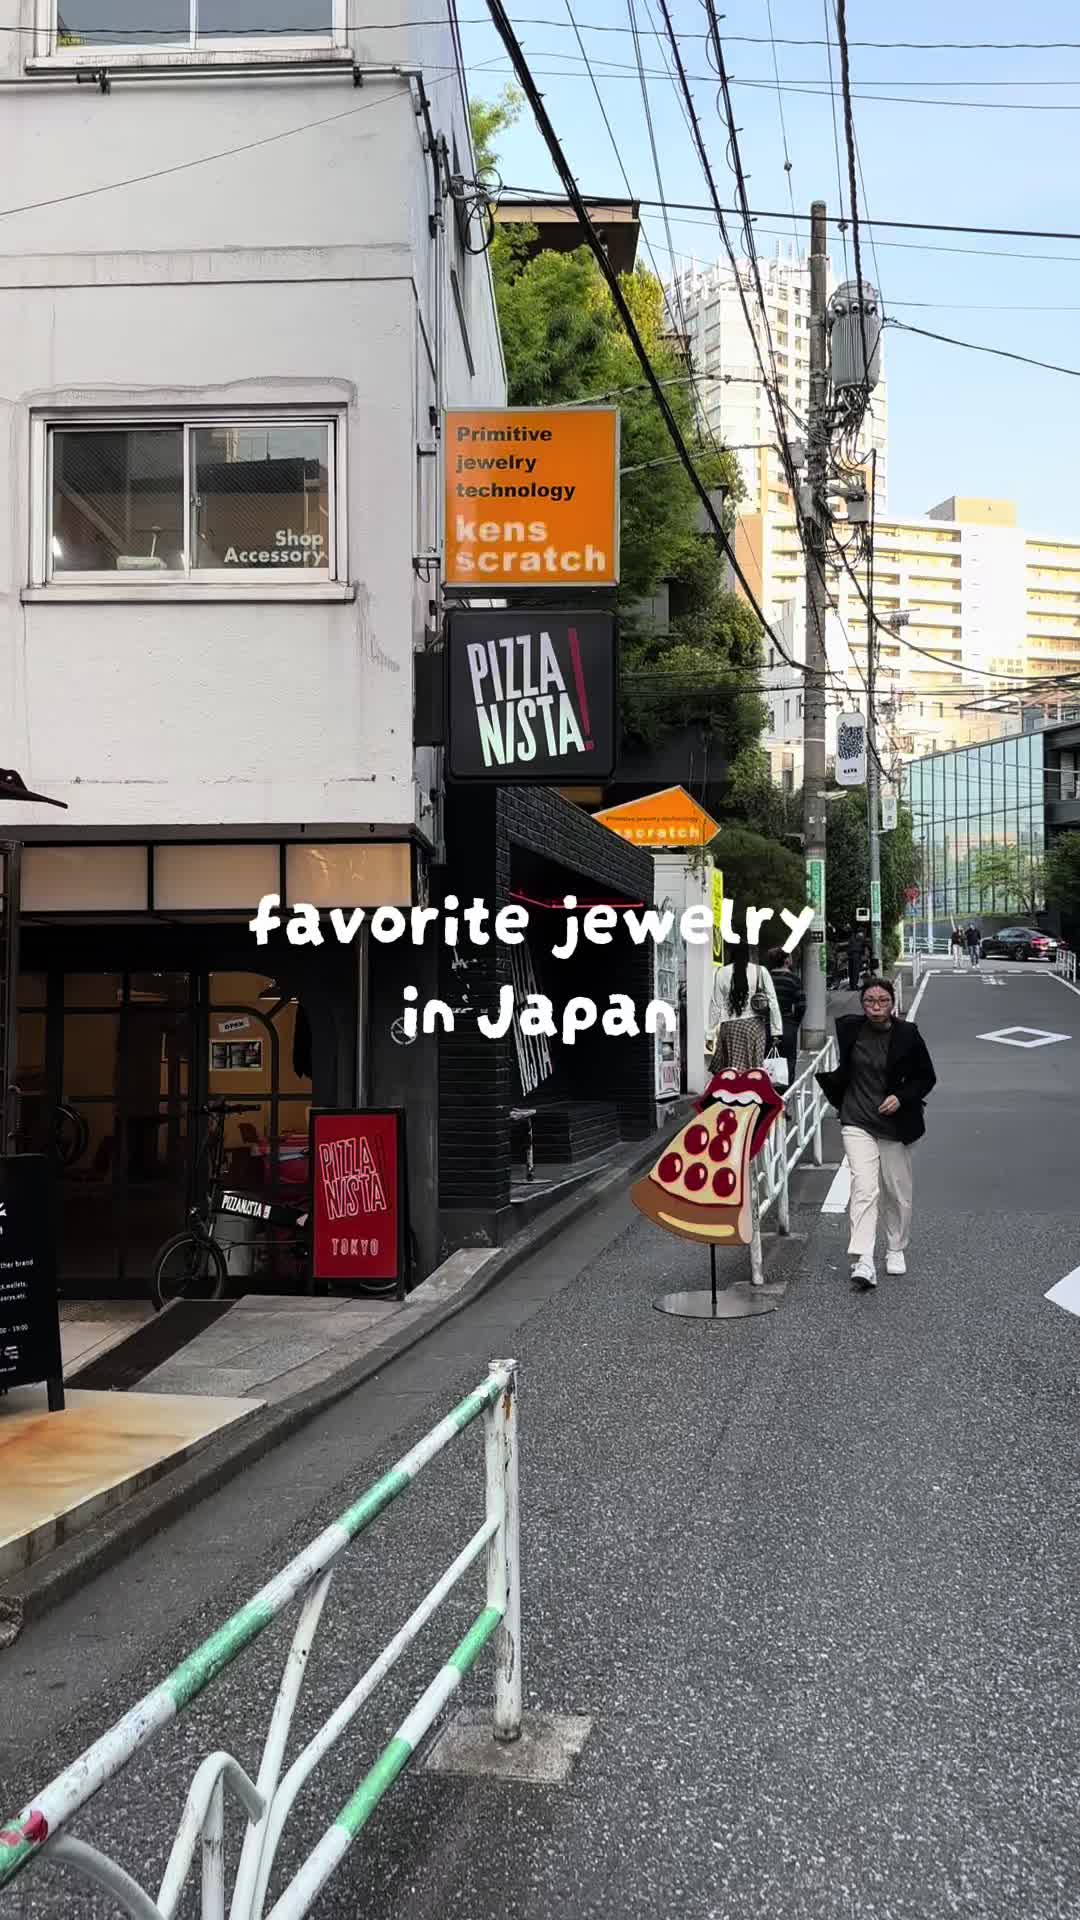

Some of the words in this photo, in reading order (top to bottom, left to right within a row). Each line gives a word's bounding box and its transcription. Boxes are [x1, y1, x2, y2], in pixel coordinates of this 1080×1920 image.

[457, 426, 552, 442] Primitive
[456, 454, 536, 473] jewelry
[456, 482, 576, 501] technology
[456, 514, 548, 543] kens
[275, 529, 324, 550] Shop
[223, 546, 325, 567] Accessory
[455, 545, 607, 572] scratch
[466, 631, 567, 705] PIZZA
[319, 1136, 377, 1182] PIZZA
[332, 1238, 379, 1256] TOKYO
